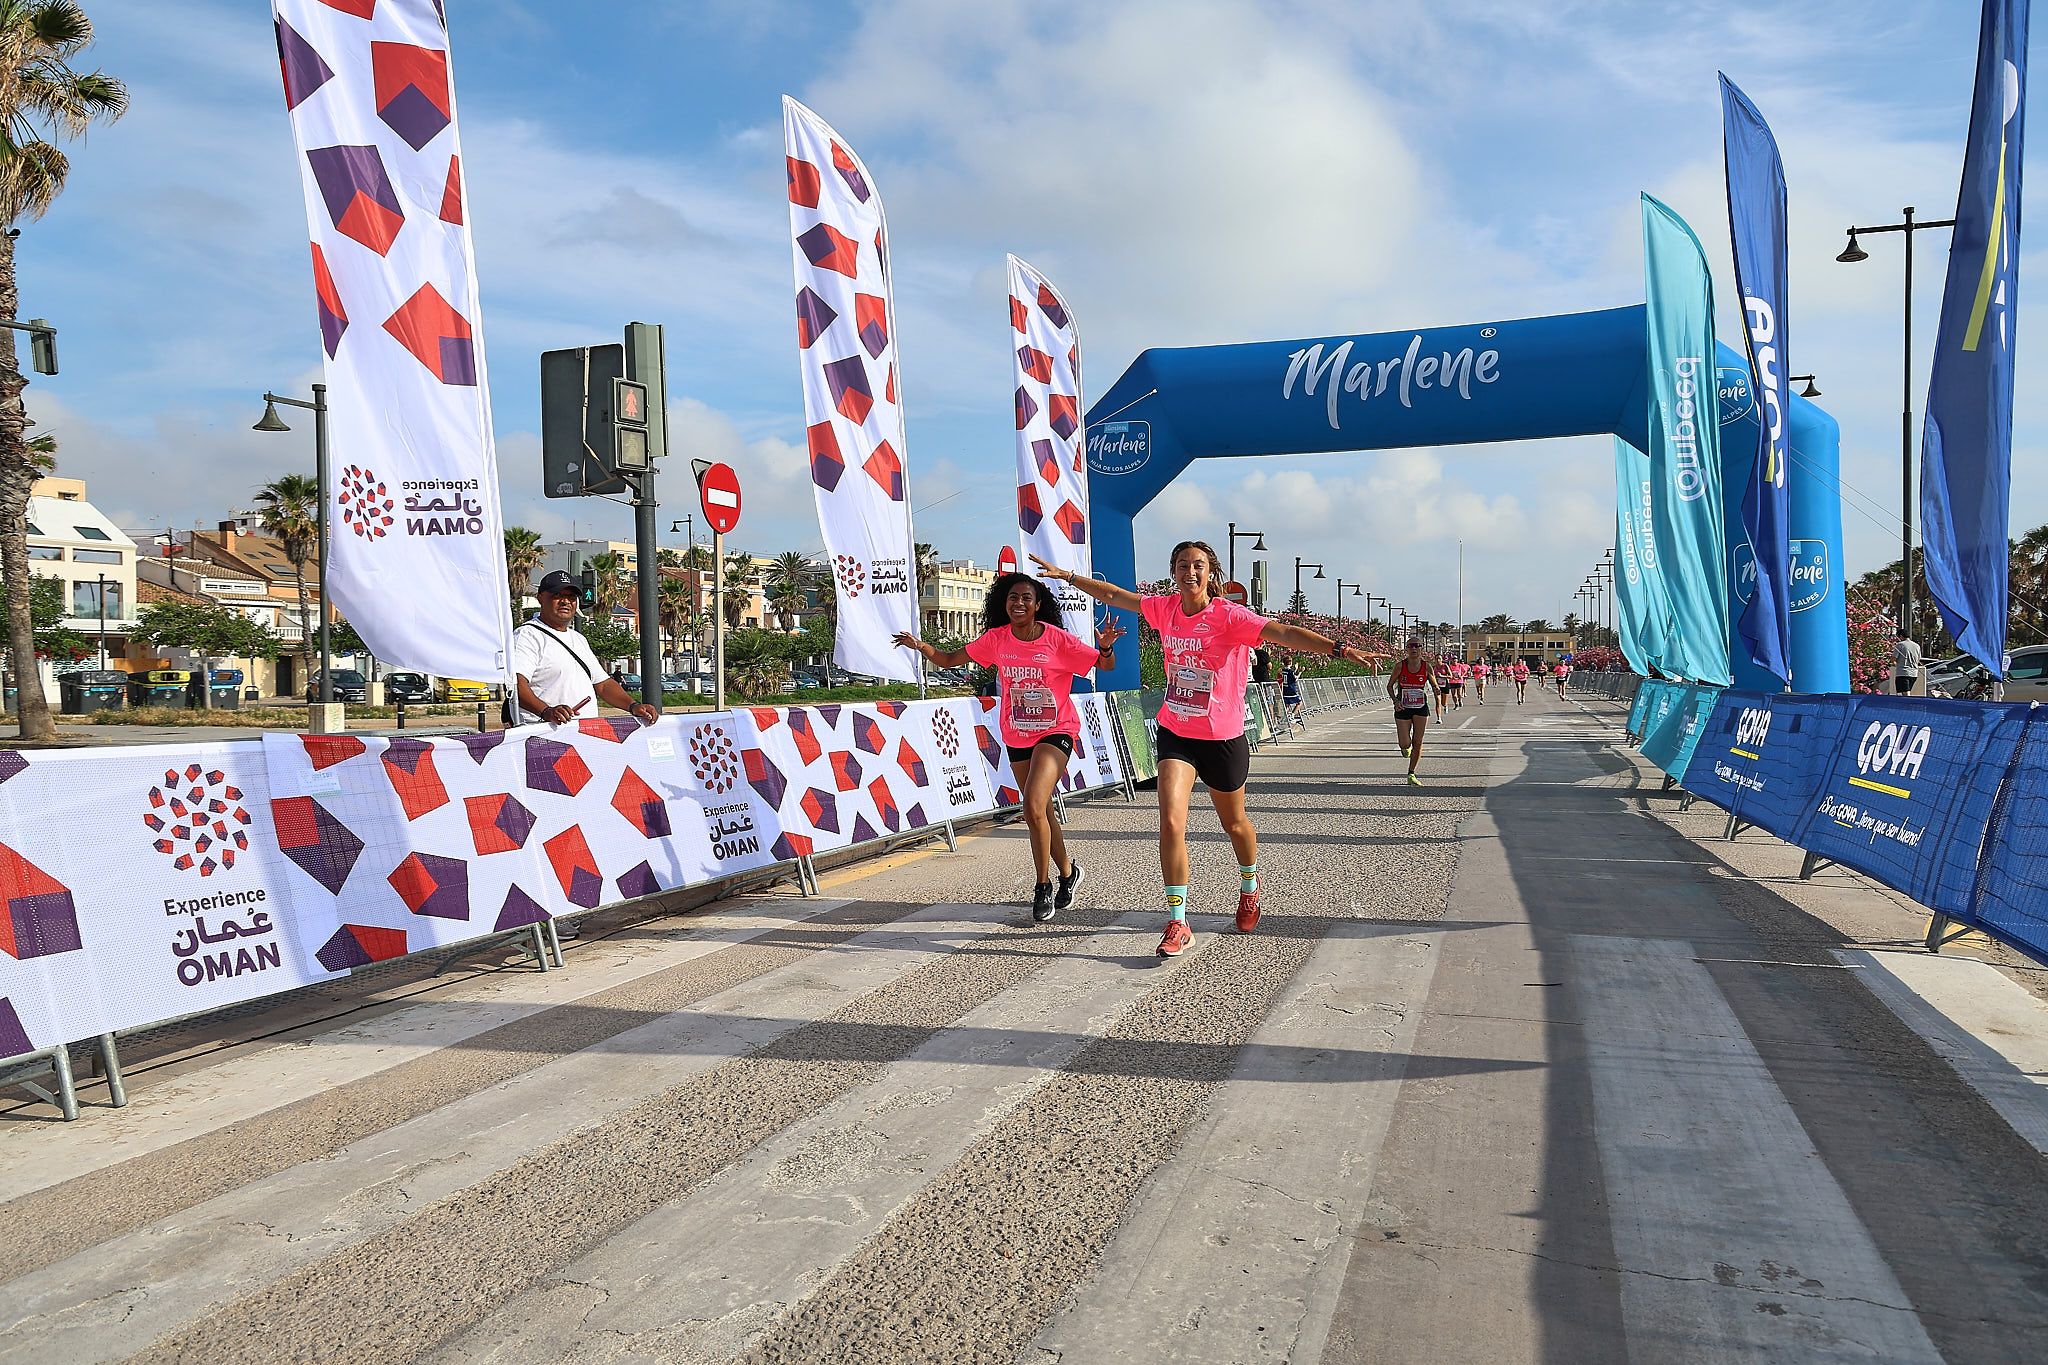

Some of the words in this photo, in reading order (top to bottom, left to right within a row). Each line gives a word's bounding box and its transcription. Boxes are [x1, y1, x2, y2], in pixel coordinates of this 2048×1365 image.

[1283, 334, 1501, 430] Marlene
[1087, 432, 1147, 461] Marlene
[1124, 459, 1142, 470] ALPES
[1797, 591, 1820, 606] ALPES
[1002, 665, 1043, 680] CARRERA
[1175, 688, 1194, 698] 016
[1736, 707, 1771, 747] GOYA
[1858, 721, 1931, 779] GOYA
[703, 802, 750, 818] Experience
[949, 789, 976, 807] OMAN
[712, 835, 760, 861] OMAN
[163, 889, 266, 917] Experience
[177, 942, 281, 987] OMAN
